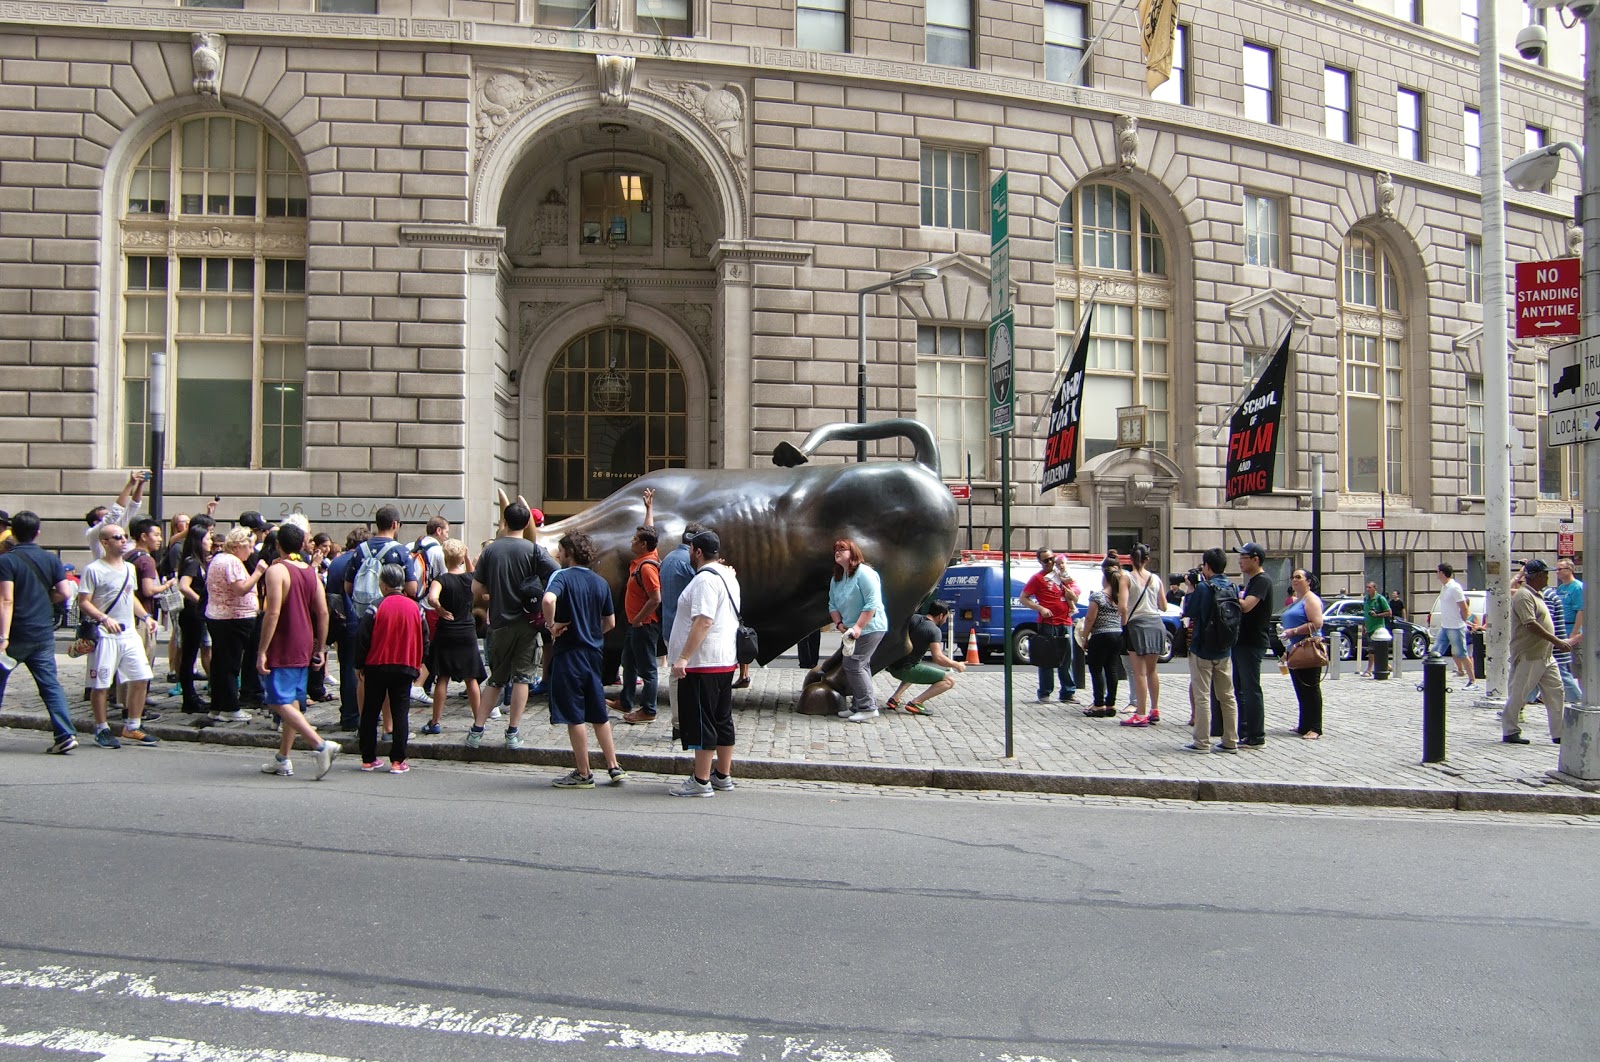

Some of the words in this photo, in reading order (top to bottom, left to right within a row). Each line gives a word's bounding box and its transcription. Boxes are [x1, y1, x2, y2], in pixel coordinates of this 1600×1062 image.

[533, 31, 558, 45] 26
[577, 32, 698, 57] BROADWAY
[1536, 268, 1559, 284] NO
[1517, 287, 1579, 303] STANDING
[1521, 303, 1576, 318] ANYTIME
[1249, 414, 1258, 427] OF
[1555, 417, 1582, 434] LOCAL
[1046, 425, 1075, 467] FILM
[1228, 421, 1274, 463] FILM
[1237, 460, 1251, 473] AND
[1226, 469, 1267, 498] ACTING
[279, 502, 304, 517] 26
[321, 503, 446, 517] BROAWAY
